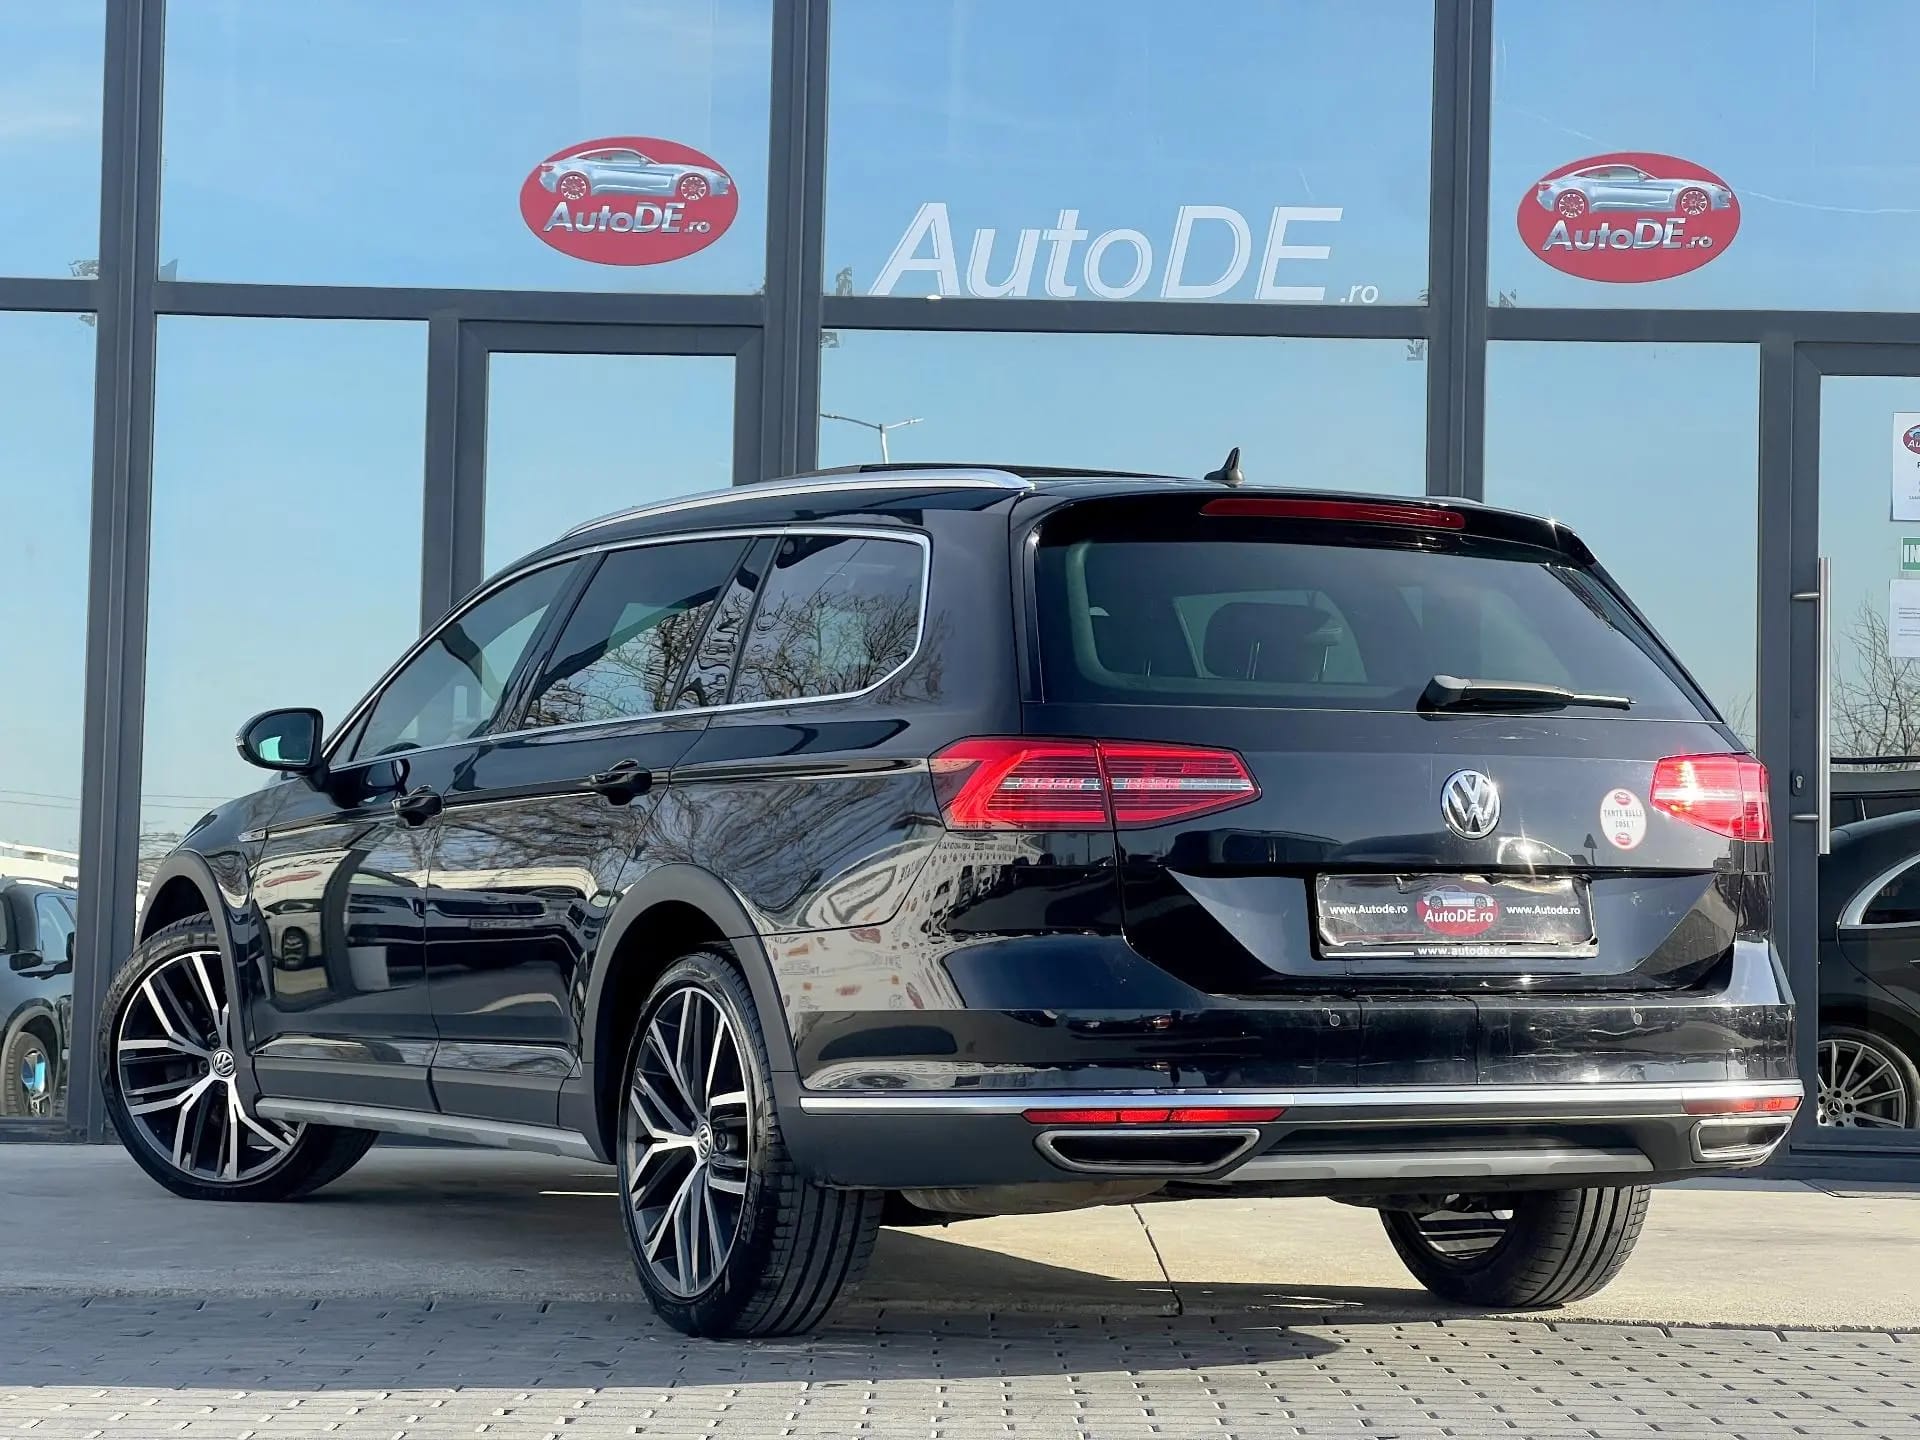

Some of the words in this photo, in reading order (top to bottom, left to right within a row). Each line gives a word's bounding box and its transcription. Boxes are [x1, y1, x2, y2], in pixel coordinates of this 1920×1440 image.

[1329, 904, 1409, 915] www.Autode.ro
[1423, 909, 1494, 923] AutoDE.ro
[1505, 905, 1581, 915] www.Autode.ro
[1417, 946, 1507, 956] www.autode.ro
